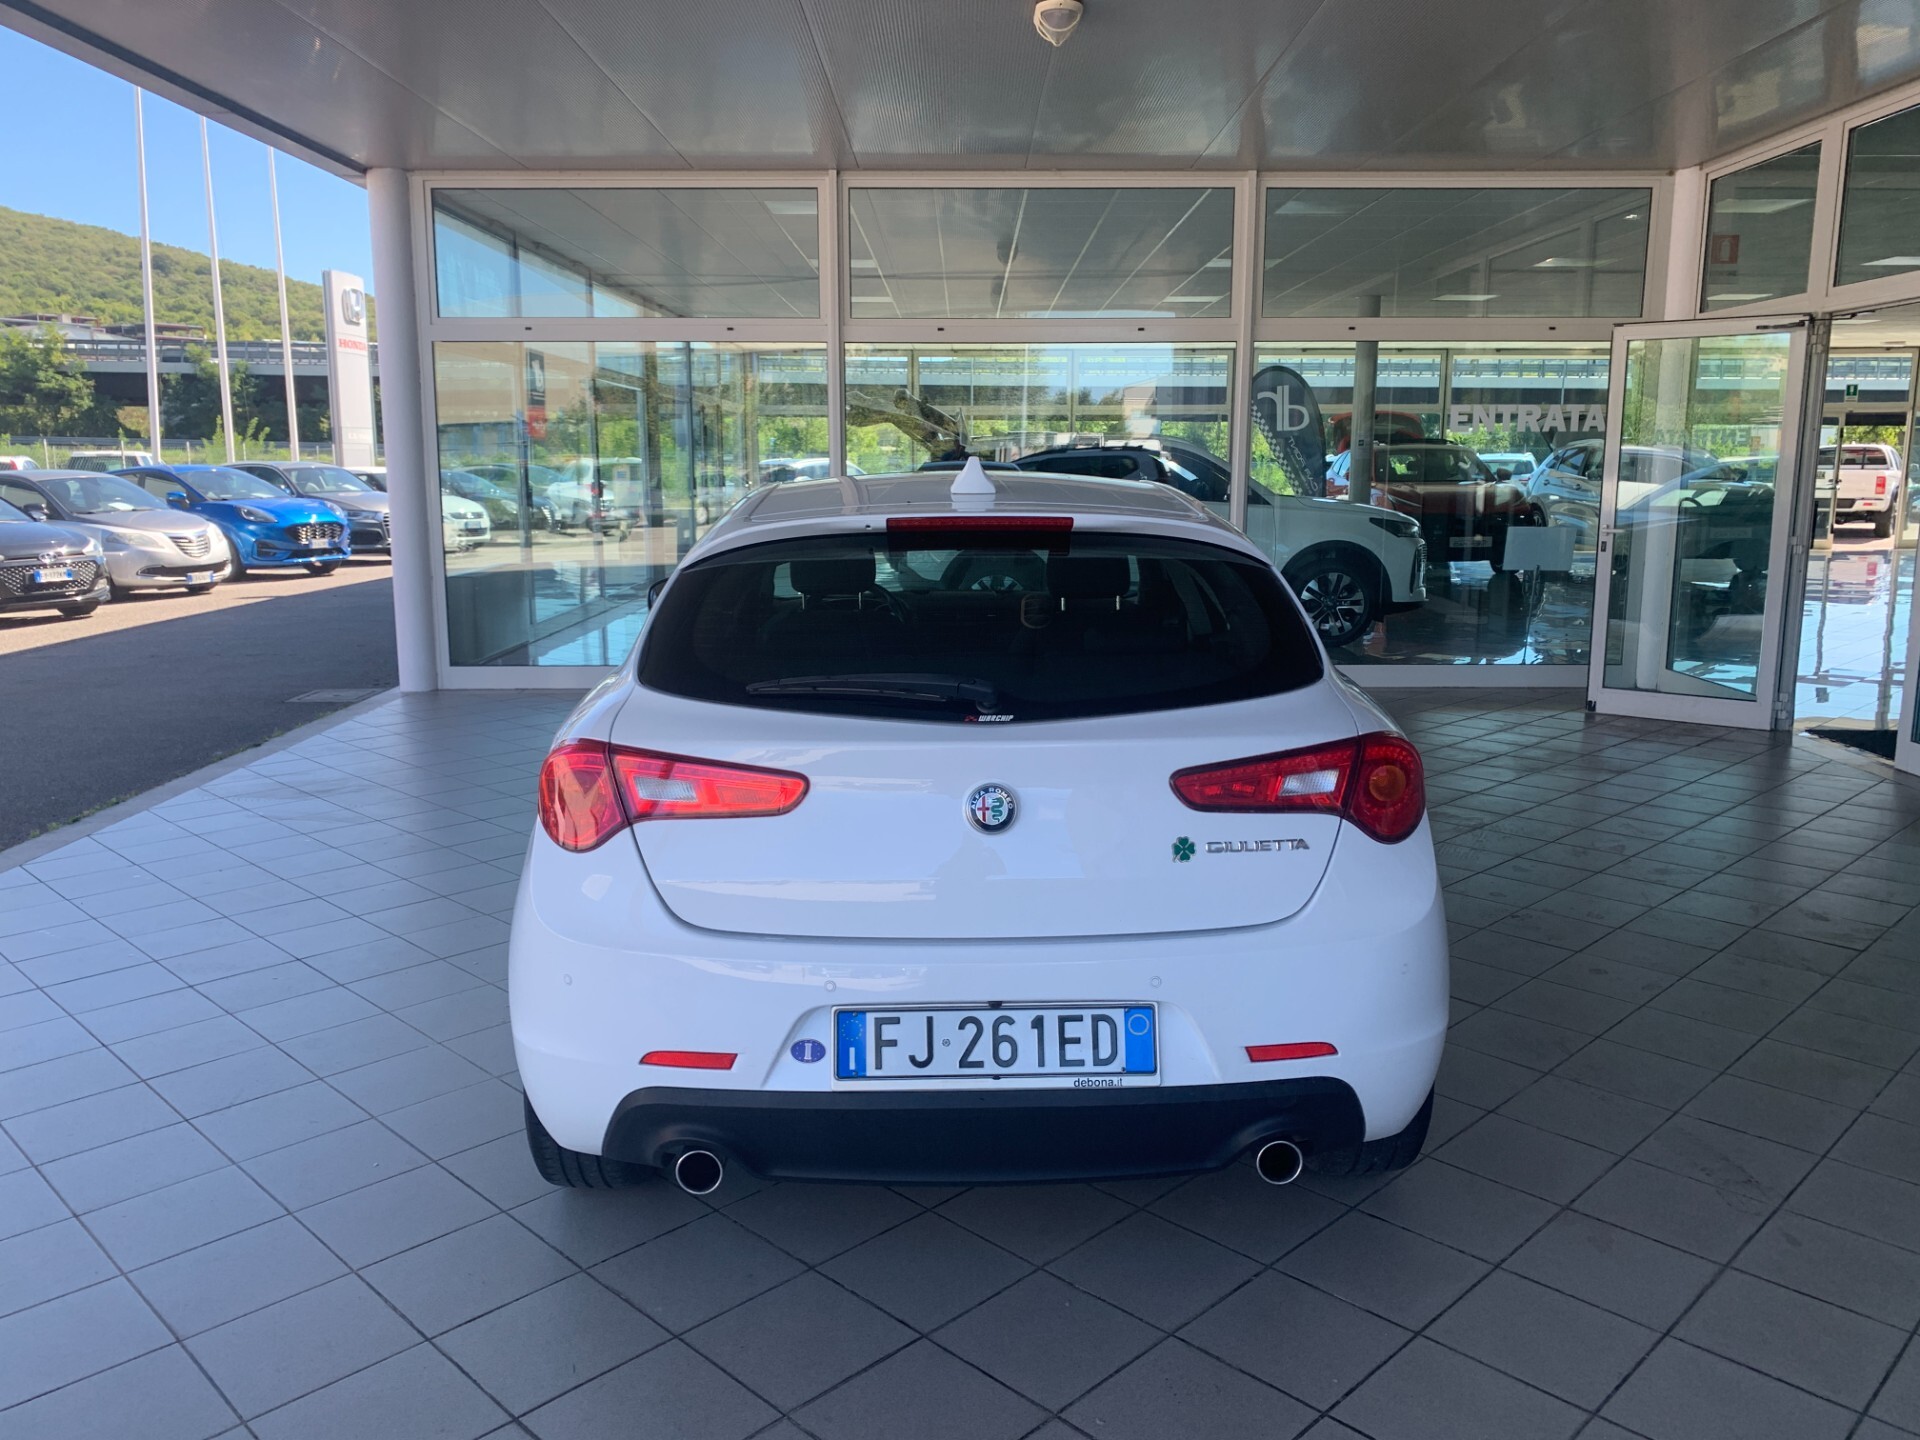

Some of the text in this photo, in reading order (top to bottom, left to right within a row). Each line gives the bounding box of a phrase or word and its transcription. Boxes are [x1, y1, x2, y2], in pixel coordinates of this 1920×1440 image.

[1450, 404, 1606, 432] ENTRATA
[971, 787, 1014, 810] ALFA ROMEO
[1205, 838, 1310, 854] GIULIETTA
[874, 1014, 1118, 1070] FJ 261ED
[1073, 1077, 1123, 1088] debona.it
